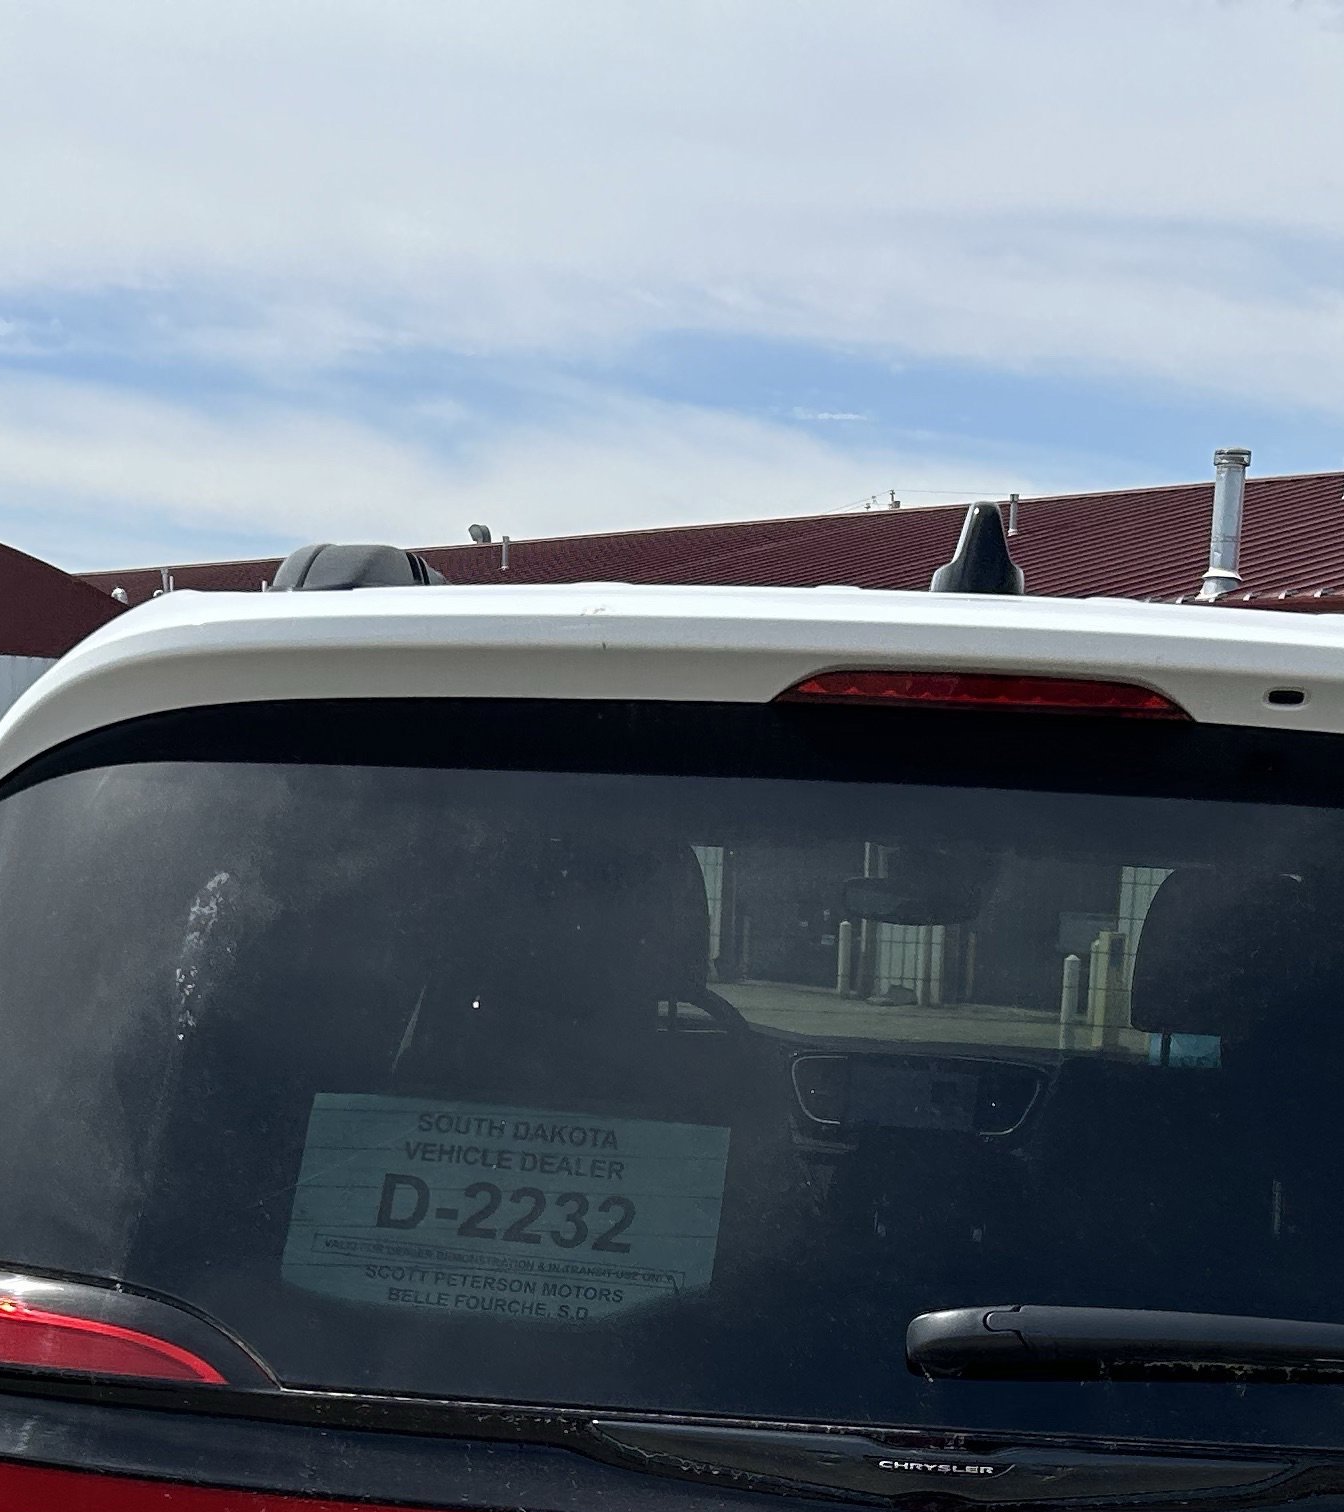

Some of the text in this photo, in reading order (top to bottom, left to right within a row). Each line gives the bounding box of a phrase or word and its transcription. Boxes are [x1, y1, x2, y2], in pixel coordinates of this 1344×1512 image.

[417, 1113, 619, 1151] SOUTH DAKOTA
[404, 1141, 625, 1181] VEHICLE DEALER
[375, 1172, 637, 1255] D-2232
[365, 1265, 624, 1304] SCOTT PETERSON MOTORS
[387, 1287, 450, 1308] BELLE
[453, 1294, 551, 1319] FOURCHE,
[878, 1460, 994, 1474] CHRYSLER
